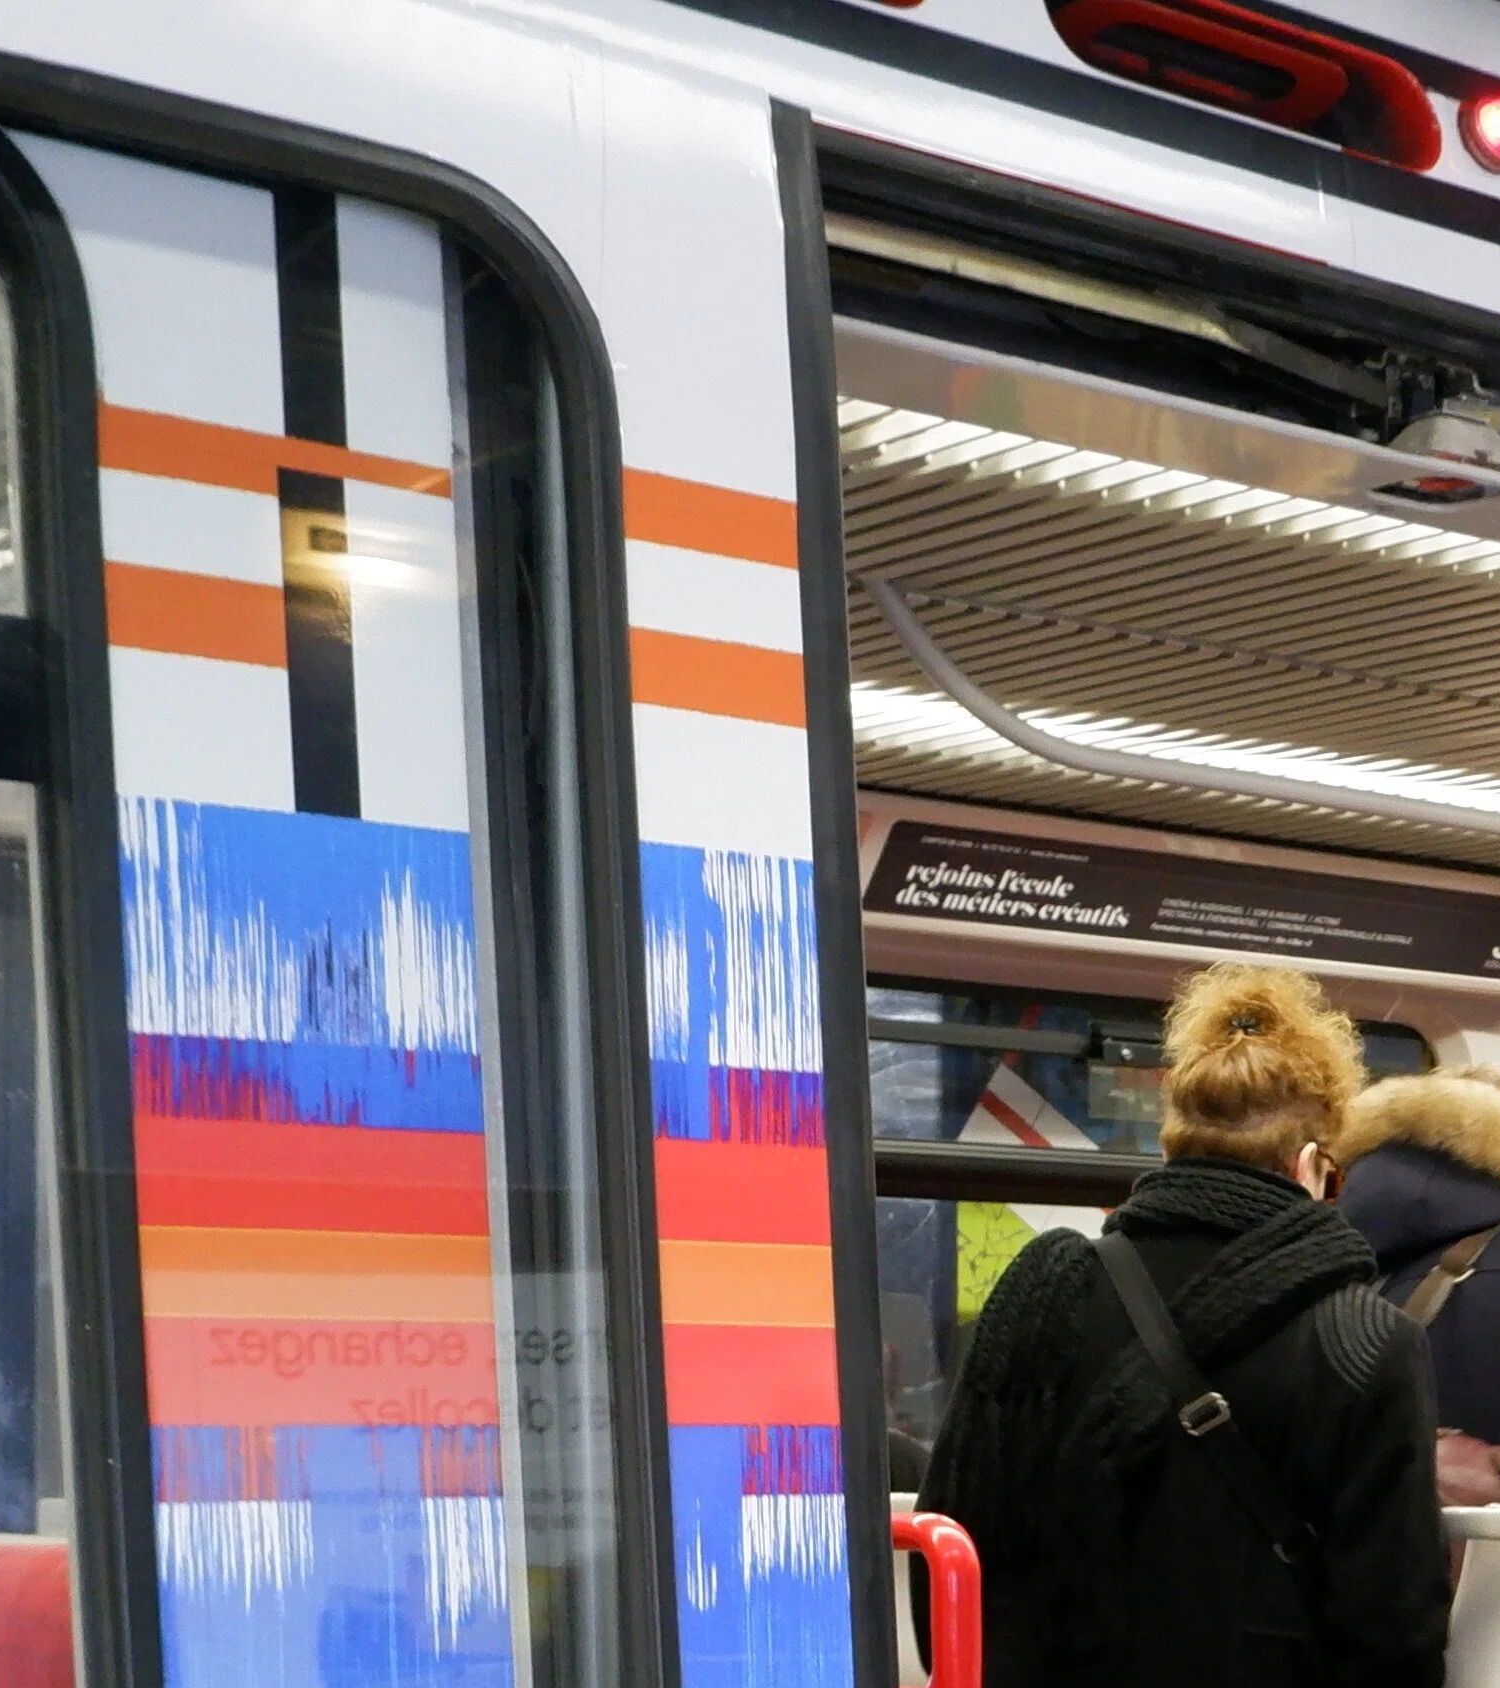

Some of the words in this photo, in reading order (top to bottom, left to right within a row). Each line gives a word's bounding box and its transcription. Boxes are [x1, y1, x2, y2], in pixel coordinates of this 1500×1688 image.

[906, 861, 997, 889] rejoins
[999, 868, 1075, 898] l'école
[895, 882, 941, 907] des
[942, 891, 1038, 917] métiers
[1038, 902, 1130, 929] créatifs
